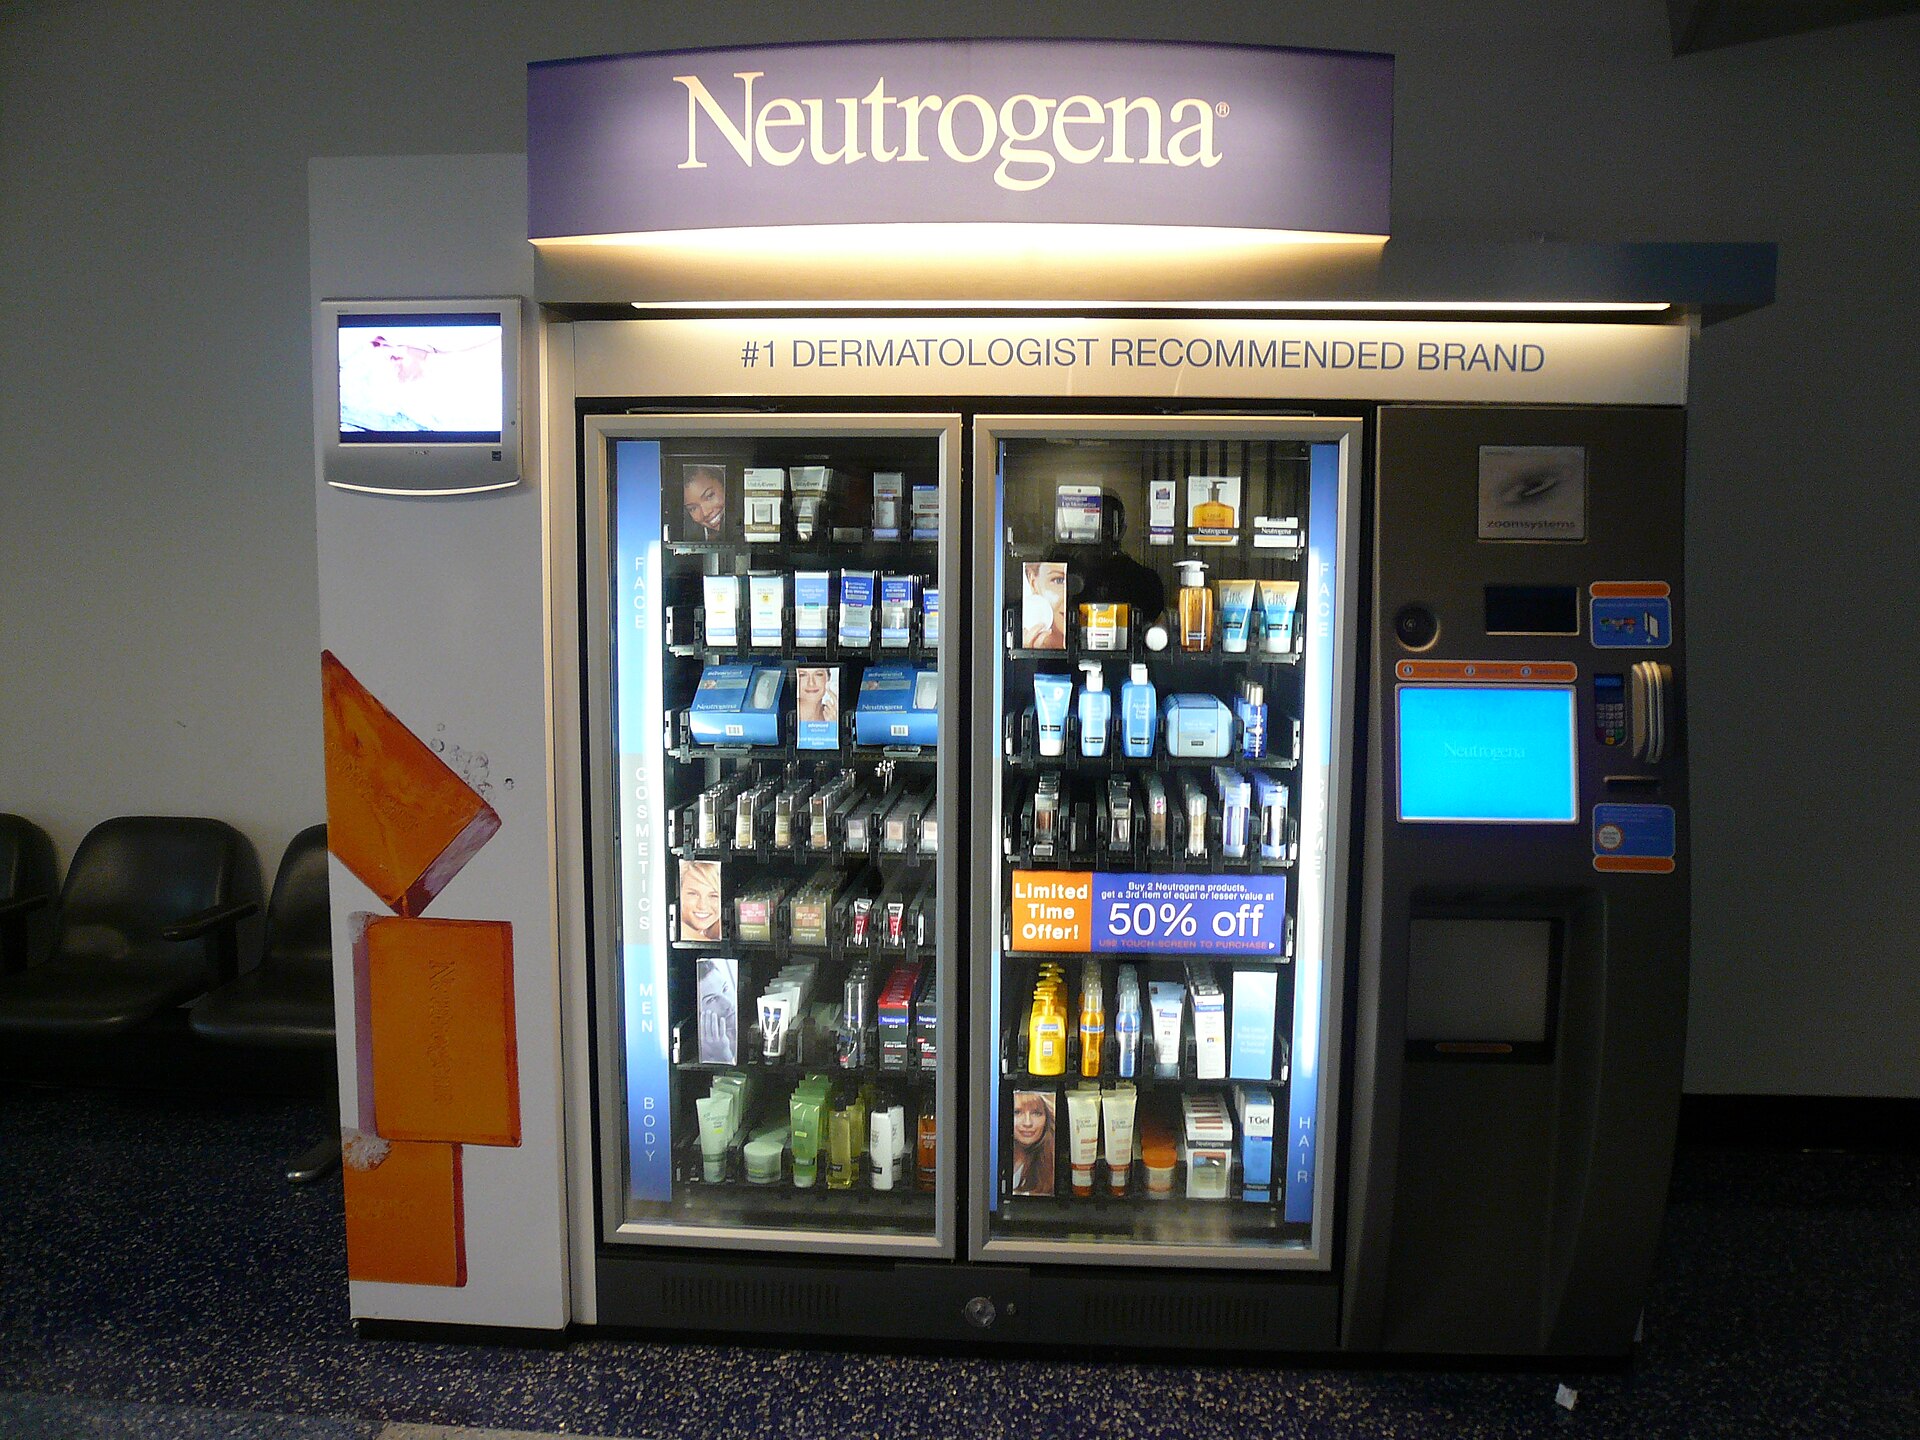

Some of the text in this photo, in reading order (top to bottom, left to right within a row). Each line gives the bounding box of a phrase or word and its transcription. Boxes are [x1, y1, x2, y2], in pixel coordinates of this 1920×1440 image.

[740, 338, 1546, 372] #1 DERMATOLOGIST RECOMMENDED BRAND
[1198, 527, 1229, 536] Neutrogena
[1261, 527, 1292, 536] Neutrogena
[1487, 519, 1577, 531] zoomsystems
[633, 556, 646, 630] FACE
[1317, 562, 1330, 638] FACE
[696, 703, 737, 712] Neutrogena
[861, 703, 903, 712] Neutrogena
[1443, 742, 1526, 762] Neutrogena
[634, 766, 652, 931] COSMETICS
[1014, 882, 1088, 900] Limited
[1101, 891, 1116, 900] get
[1126, 891, 1140, 900] 3rd
[1163, 891, 1172, 899] of
[1174, 892, 1198, 901] equal
[1212, 892, 1237, 901] lesser
[1239, 893, 1263, 901] value
[1265, 893, 1275, 901] at
[1128, 882, 1248, 894] Buy 2 Neutrogena products,
[1027, 903, 1075, 920] Time
[1108, 902, 1265, 937] 50% off
[1022, 924, 1079, 941] Offer!
[1100, 940, 1117, 948] USE
[1200, 941, 1213, 949] TO
[1216, 941, 1267, 950] PURCHASE
[639, 983, 654, 1035] MEN
[643, 1096, 656, 1163] BODY
[1296, 1116, 1311, 1184] HAIR
